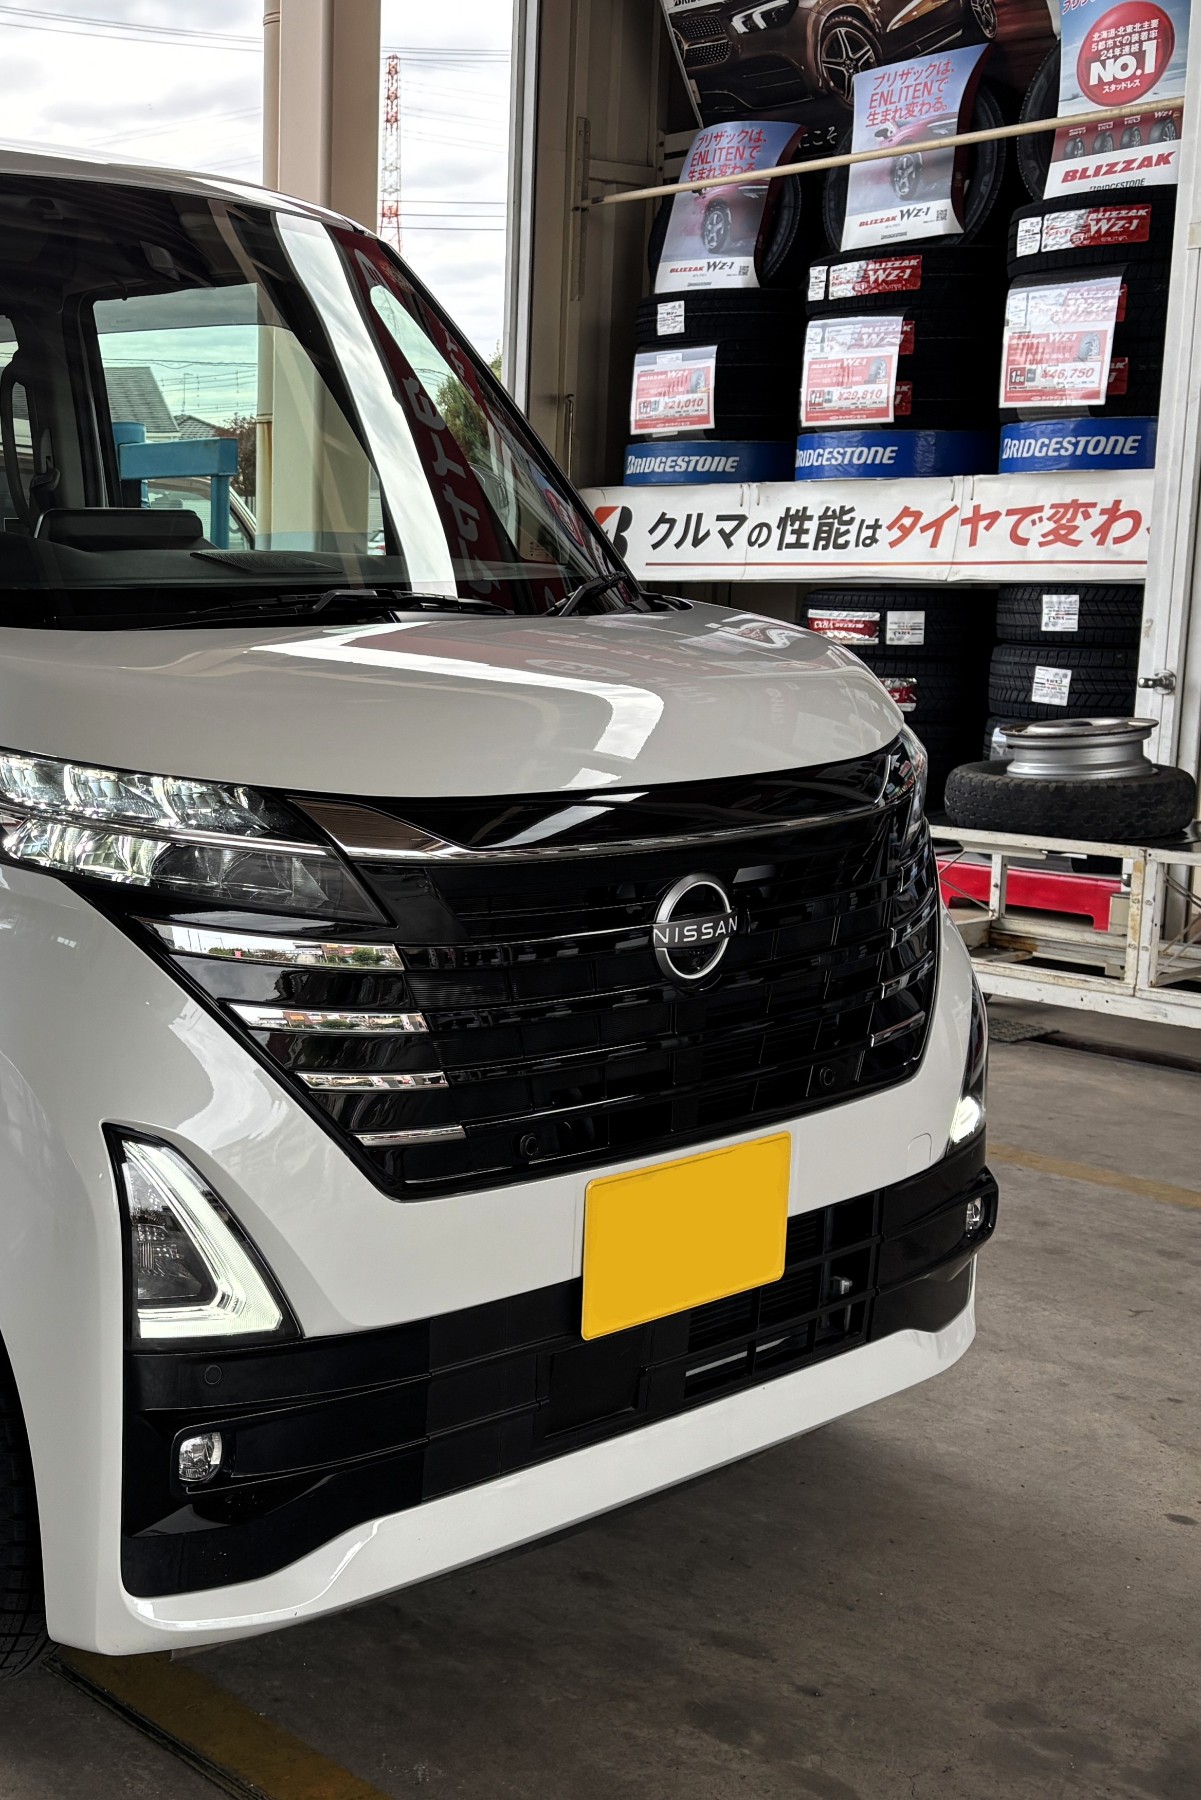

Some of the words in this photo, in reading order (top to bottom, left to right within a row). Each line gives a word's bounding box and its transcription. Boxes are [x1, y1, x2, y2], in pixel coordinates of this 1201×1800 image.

[1100, 44, 1139, 61] 24年連続
[1089, 39, 1157, 86] NO.1
[1102, 79, 1141, 94] スタッドレス
[1061, 151, 1176, 184] BLIZZAK
[858, 215, 898, 227] BLIZZAK
[899, 206, 930, 223] WZ-1
[1088, 208, 1149, 221] BLIZZAK
[1089, 218, 1140, 237] WZ-1
[669, 266, 705, 274] BLIZZAK
[706, 260, 735, 272] WZ-1
[866, 258, 920, 271] BLIZZAK
[868, 268, 913, 285] WZ-1
[1002, 434, 1142, 460] BRIDGESTONE
[626, 455, 740, 475] BRIDGESTONE
[648, 498, 1151, 551] クルマの性能はタイヤで変わ
[653, 915, 738, 944] NISSAN
